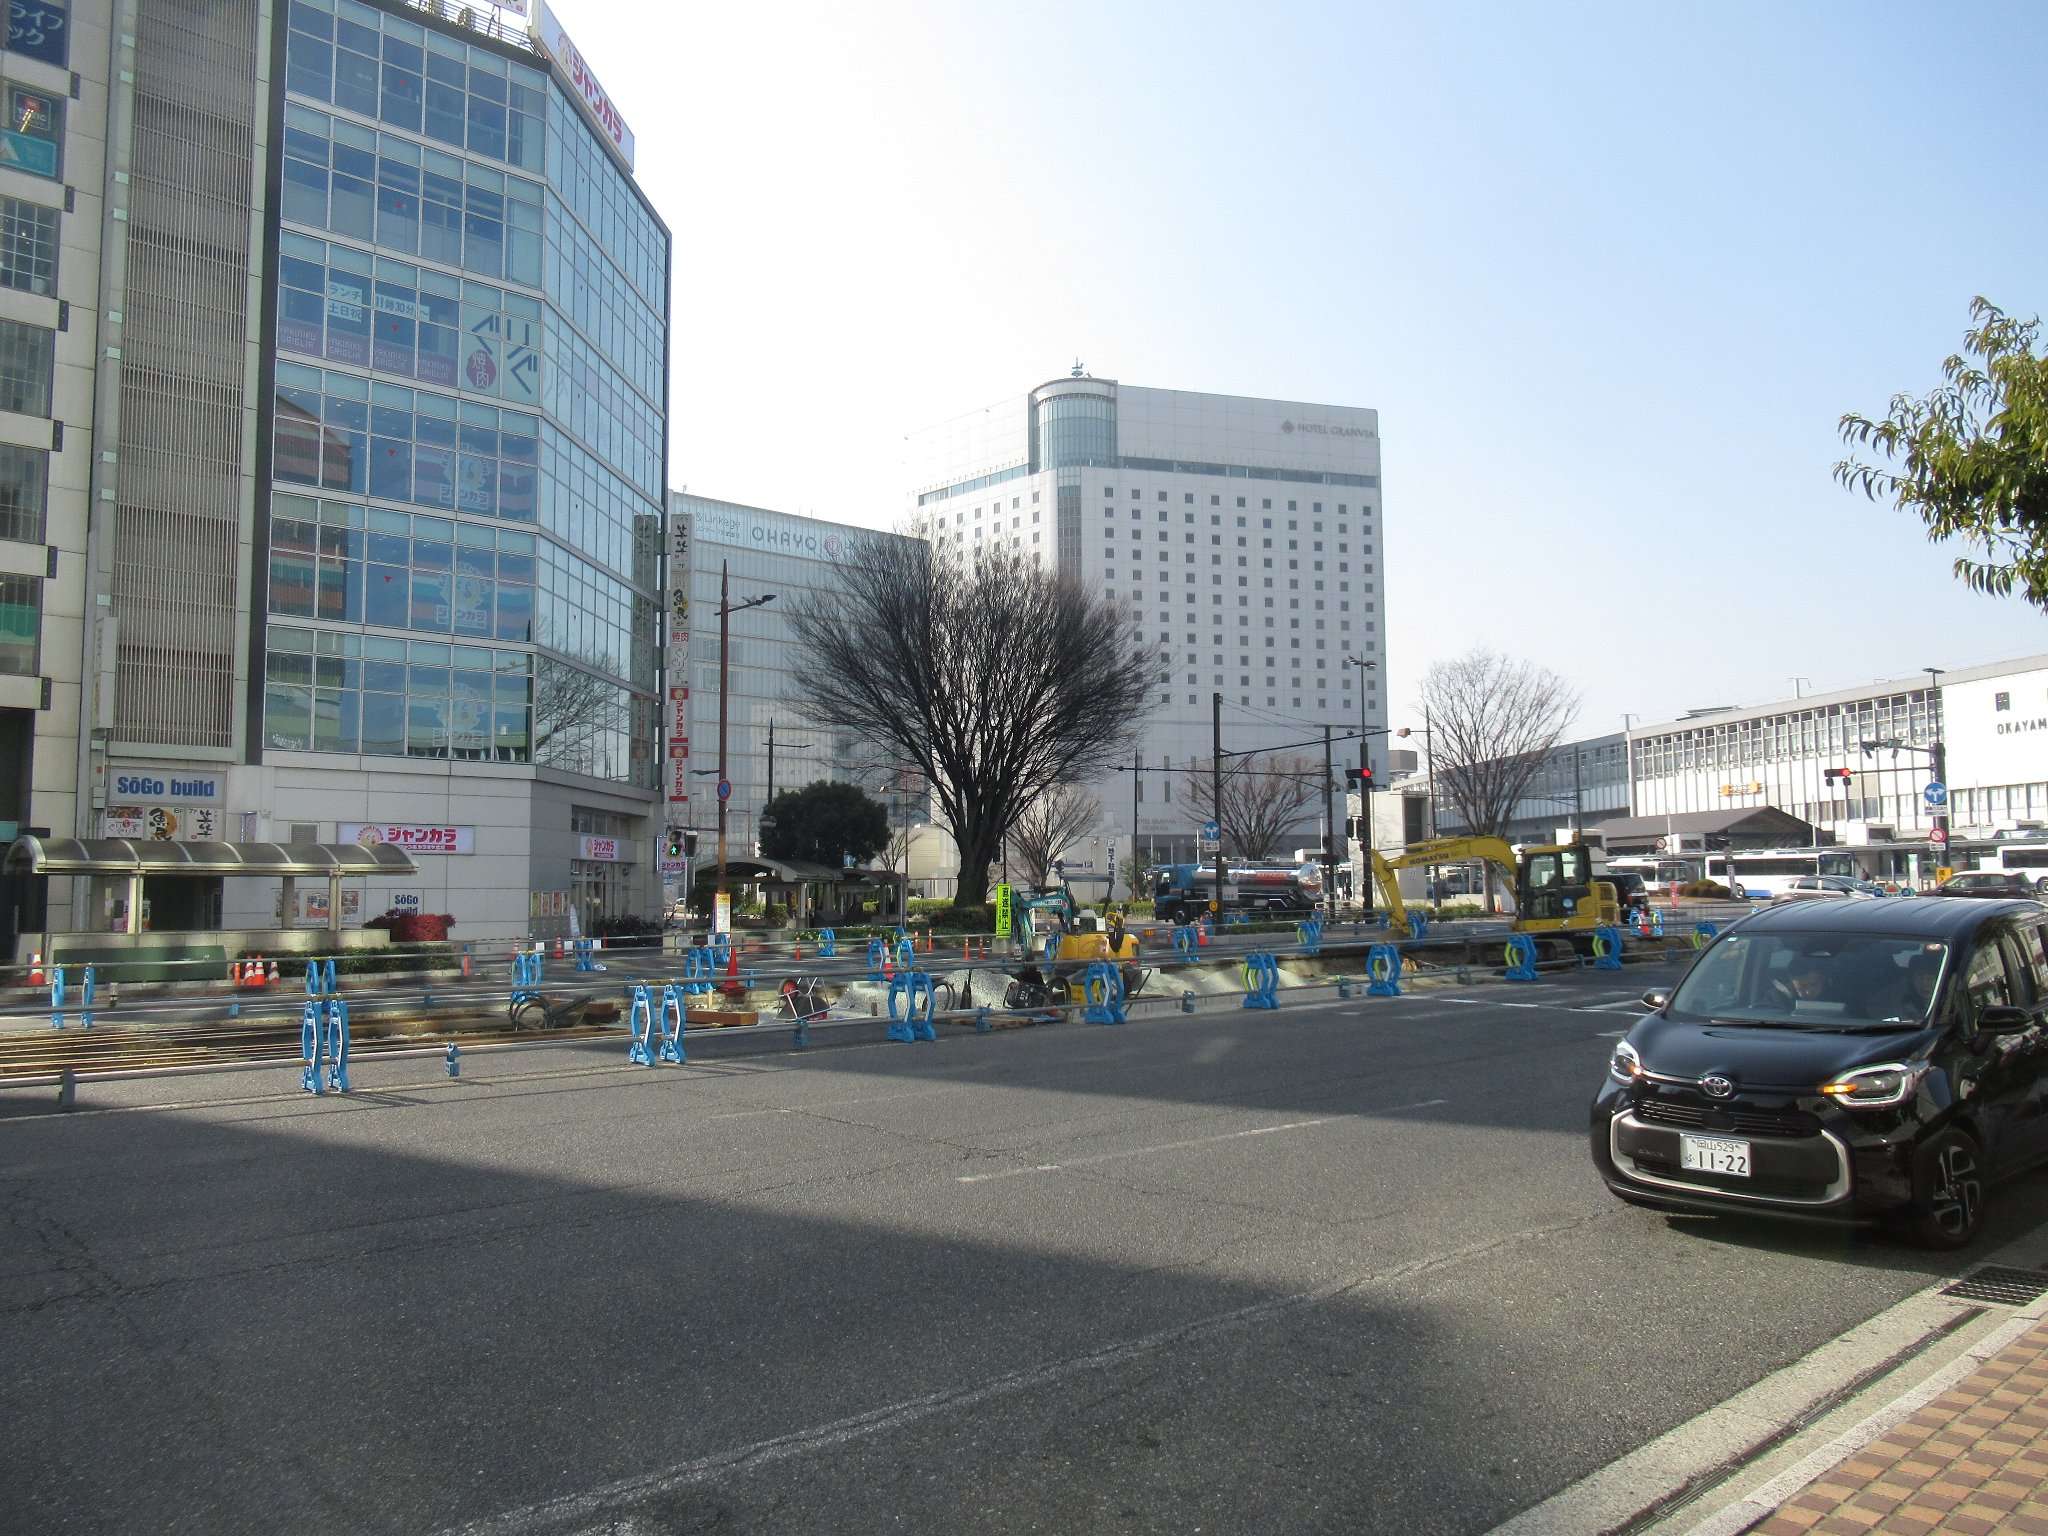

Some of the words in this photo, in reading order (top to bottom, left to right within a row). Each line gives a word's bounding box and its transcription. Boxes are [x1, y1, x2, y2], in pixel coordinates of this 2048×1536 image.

[572, 51, 622, 144] ジャンカラ
[329, 284, 362, 300] ランチ
[328, 303, 362, 321] 土日祝
[473, 353, 491, 388] 焼肉
[1297, 423, 1328, 434] HOTEL
[752, 516, 816, 551] OHAYO
[675, 700, 683, 737] ジャンカラ
[1997, 718, 2047, 735] OKAYAM
[675, 760, 683, 796] ジャンカラ
[170, 778, 214, 797] build
[388, 827, 457, 843] ジャンカラ
[594, 840, 614, 853] ジャンカラ
[1717, 1141, 1735, 1152] 529
[1699, 1150, 1747, 1174] 11-22
